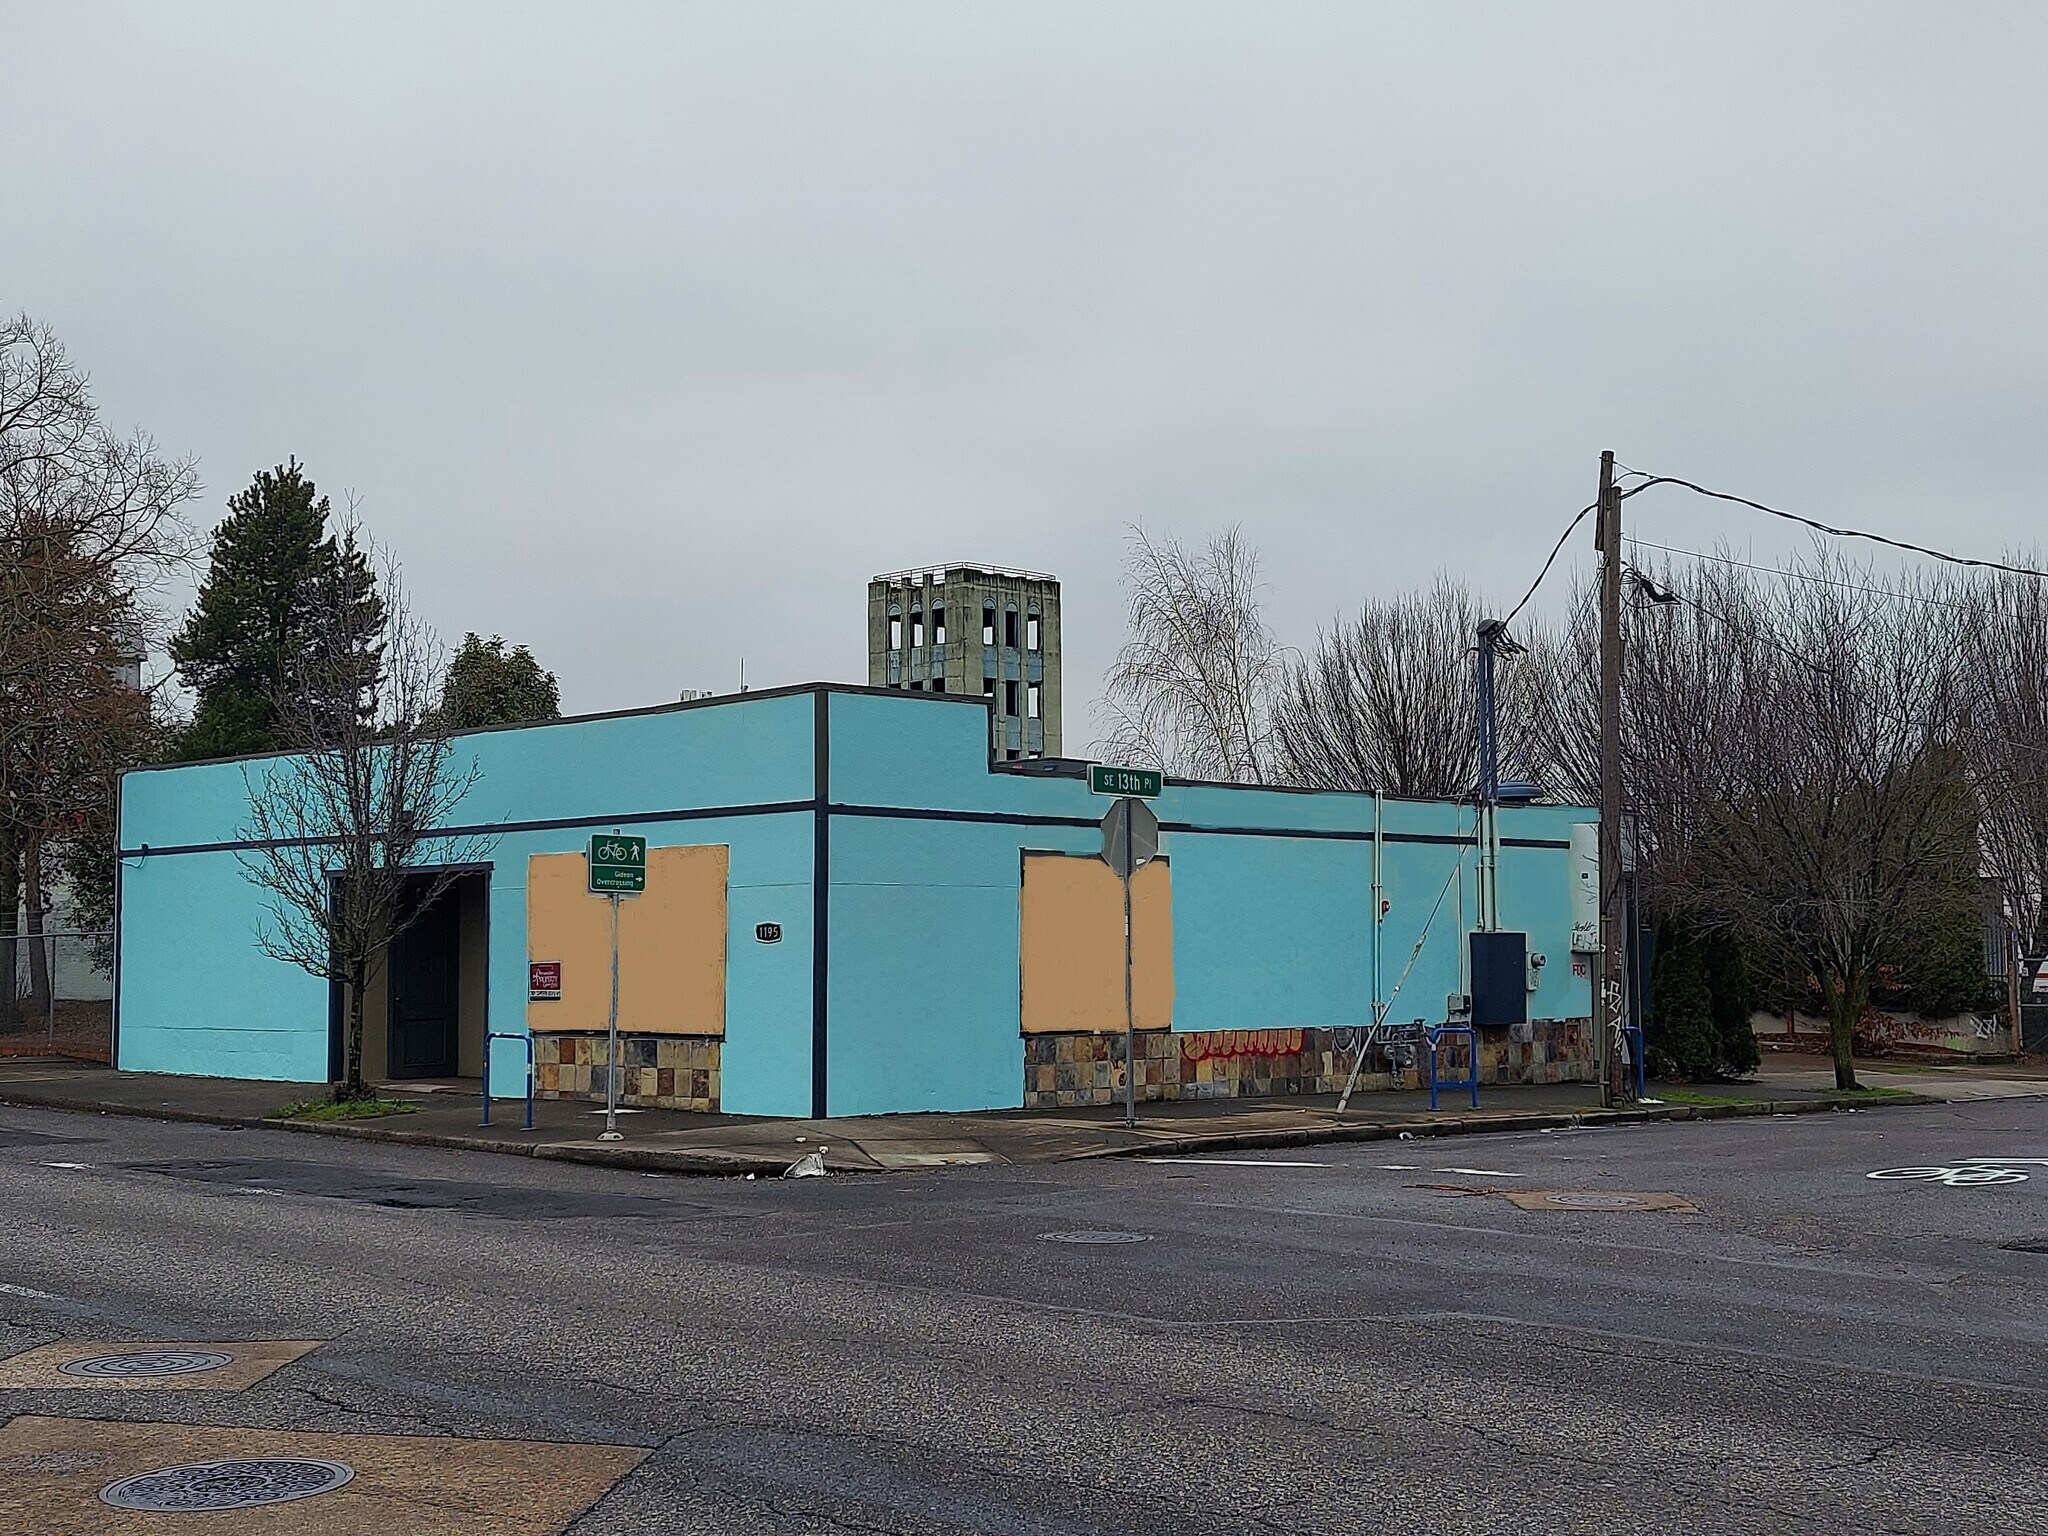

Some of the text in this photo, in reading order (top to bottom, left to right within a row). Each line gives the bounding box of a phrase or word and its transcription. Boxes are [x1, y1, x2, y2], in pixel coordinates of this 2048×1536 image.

[1103, 774, 1114, 787] SE
[1118, 773, 1141, 791] 13th
[614, 870, 634, 878] Gideon
[596, 878, 634, 888] Overcrossing
[759, 926, 778, 938] 1195
